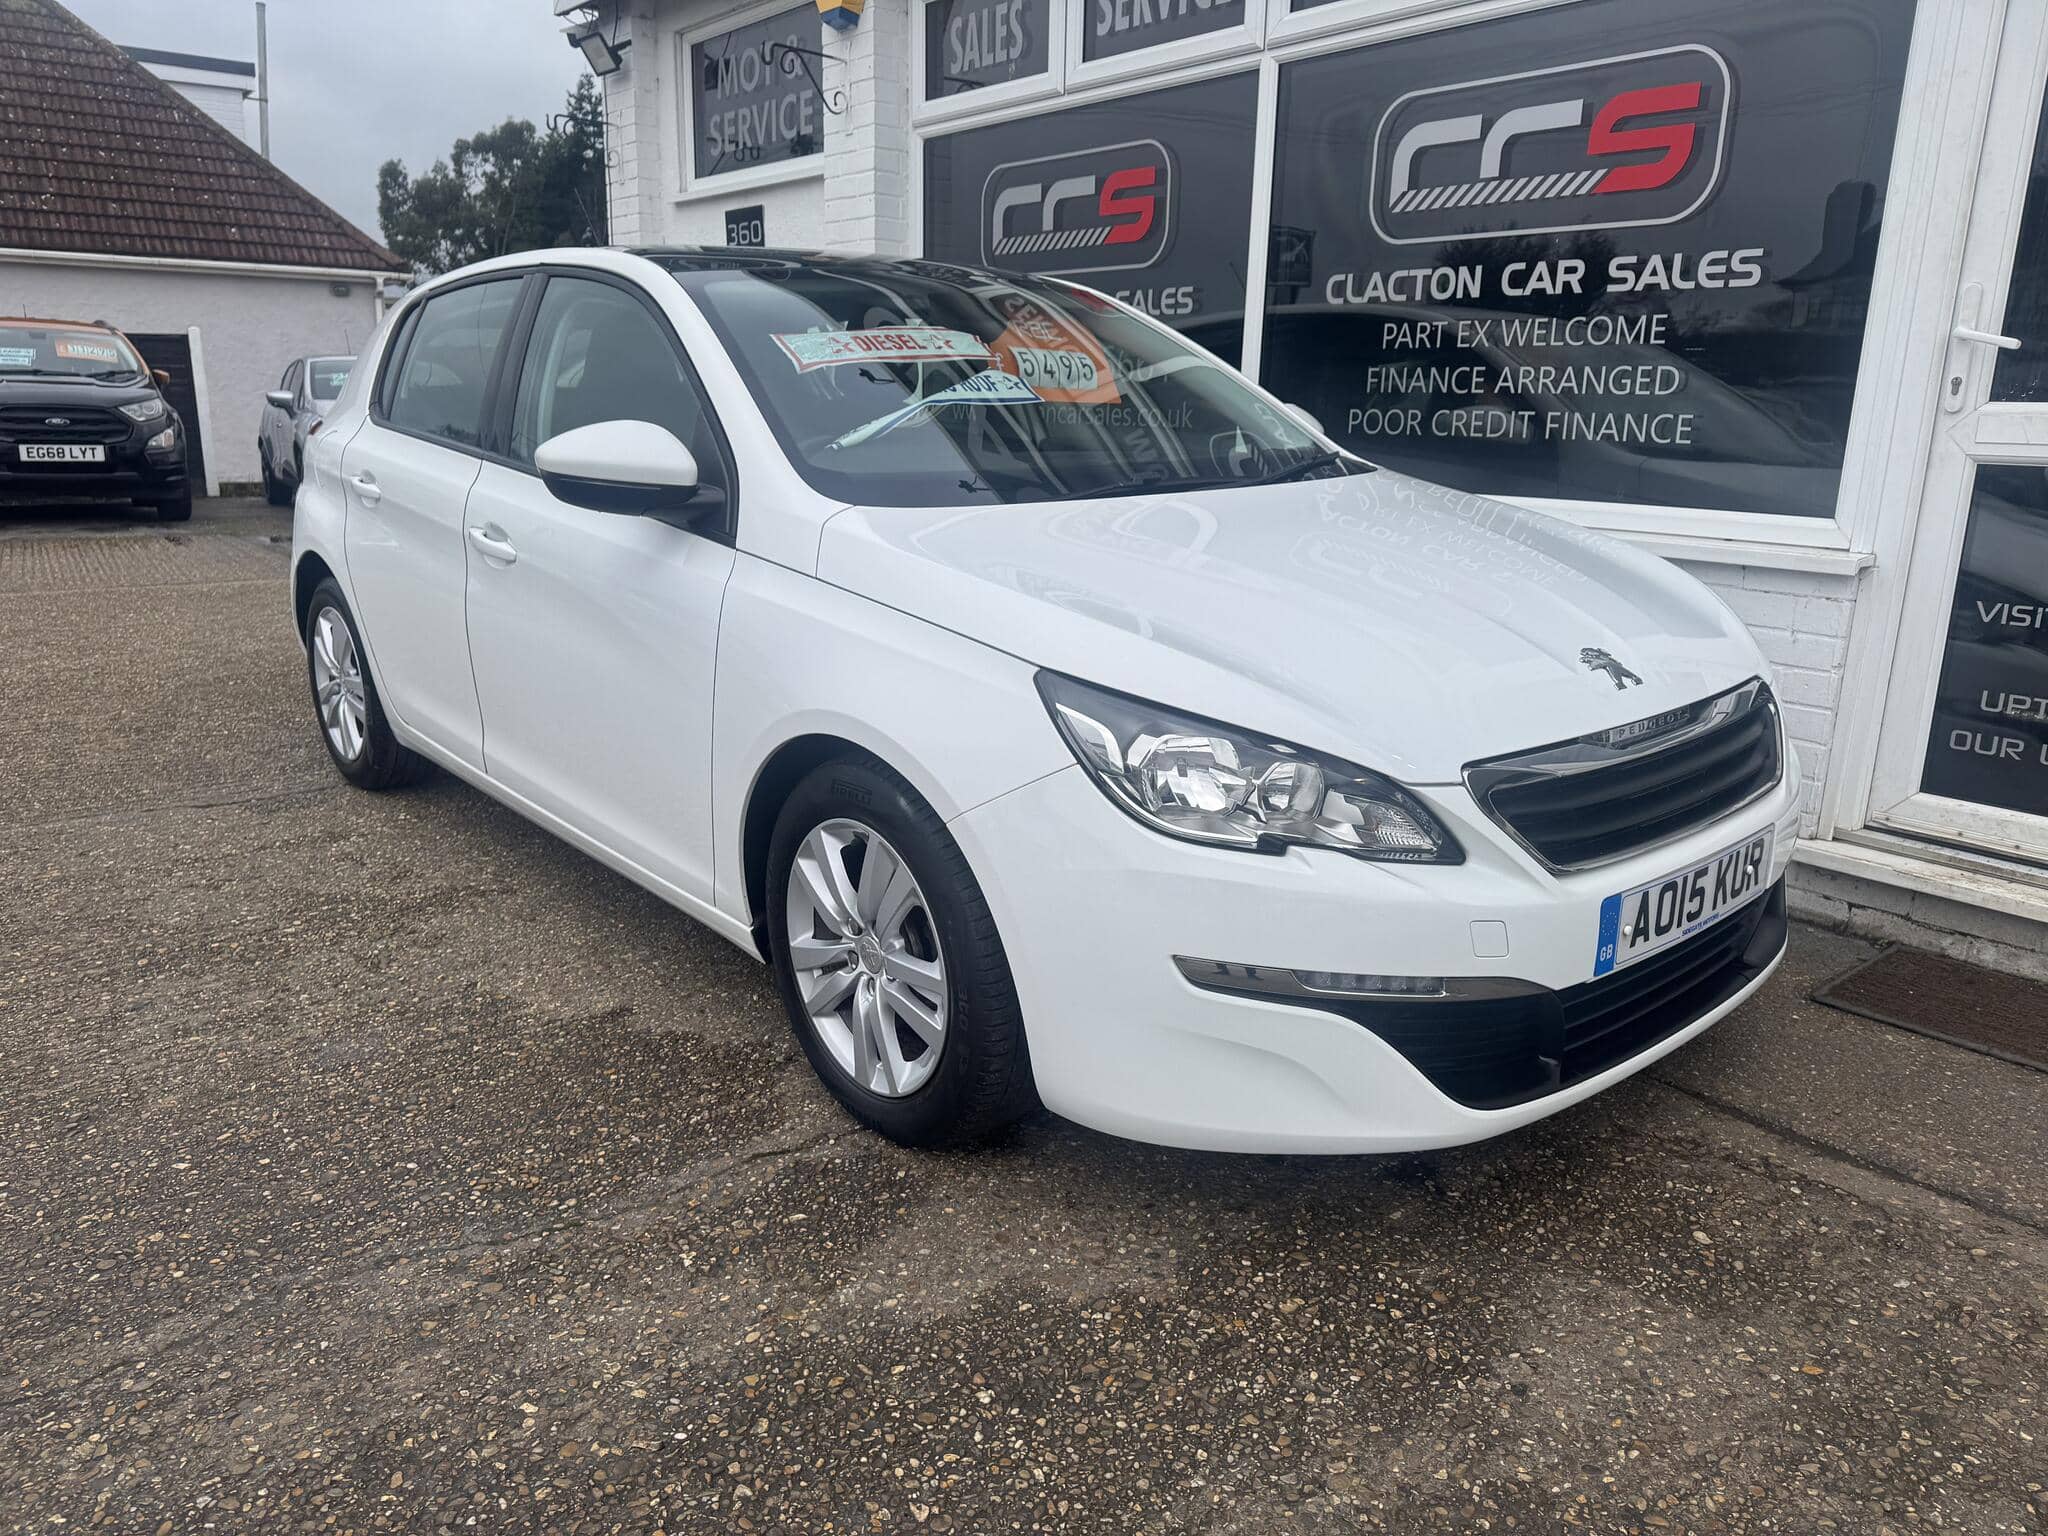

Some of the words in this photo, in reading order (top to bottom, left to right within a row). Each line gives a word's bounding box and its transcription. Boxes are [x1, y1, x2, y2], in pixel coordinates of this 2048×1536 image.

[949, 0, 1023, 75] SALES
[710, 89, 814, 157] SERVICE
[727, 220, 762, 246] 360
[1326, 264, 1483, 305] CLACTON
[1501, 258, 1586, 297] CAR
[1606, 247, 1765, 292] SALES
[852, 333, 928, 353] DIESEL
[1382, 321, 1449, 350] PART
[1457, 319, 1492, 348] EX
[1501, 313, 1669, 348] WELCOME
[1016, 351, 1094, 383] 5495
[1366, 366, 1486, 394] FINANCE
[1494, 365, 1681, 396] ARRANGED
[1348, 408, 1423, 437] POOR
[1431, 409, 1536, 439] CREDIT
[1545, 411, 1694, 445] FINANCE
[26, 447, 66, 459] EG68
[69, 447, 97, 459] LYT
[1976, 600, 2048, 629] VISI
[1949, 729, 2025, 761] OUR
[1629, 866, 1710, 949] AO15
[1712, 836, 1766, 910] KUR
[1599, 943, 1613, 963] GB
